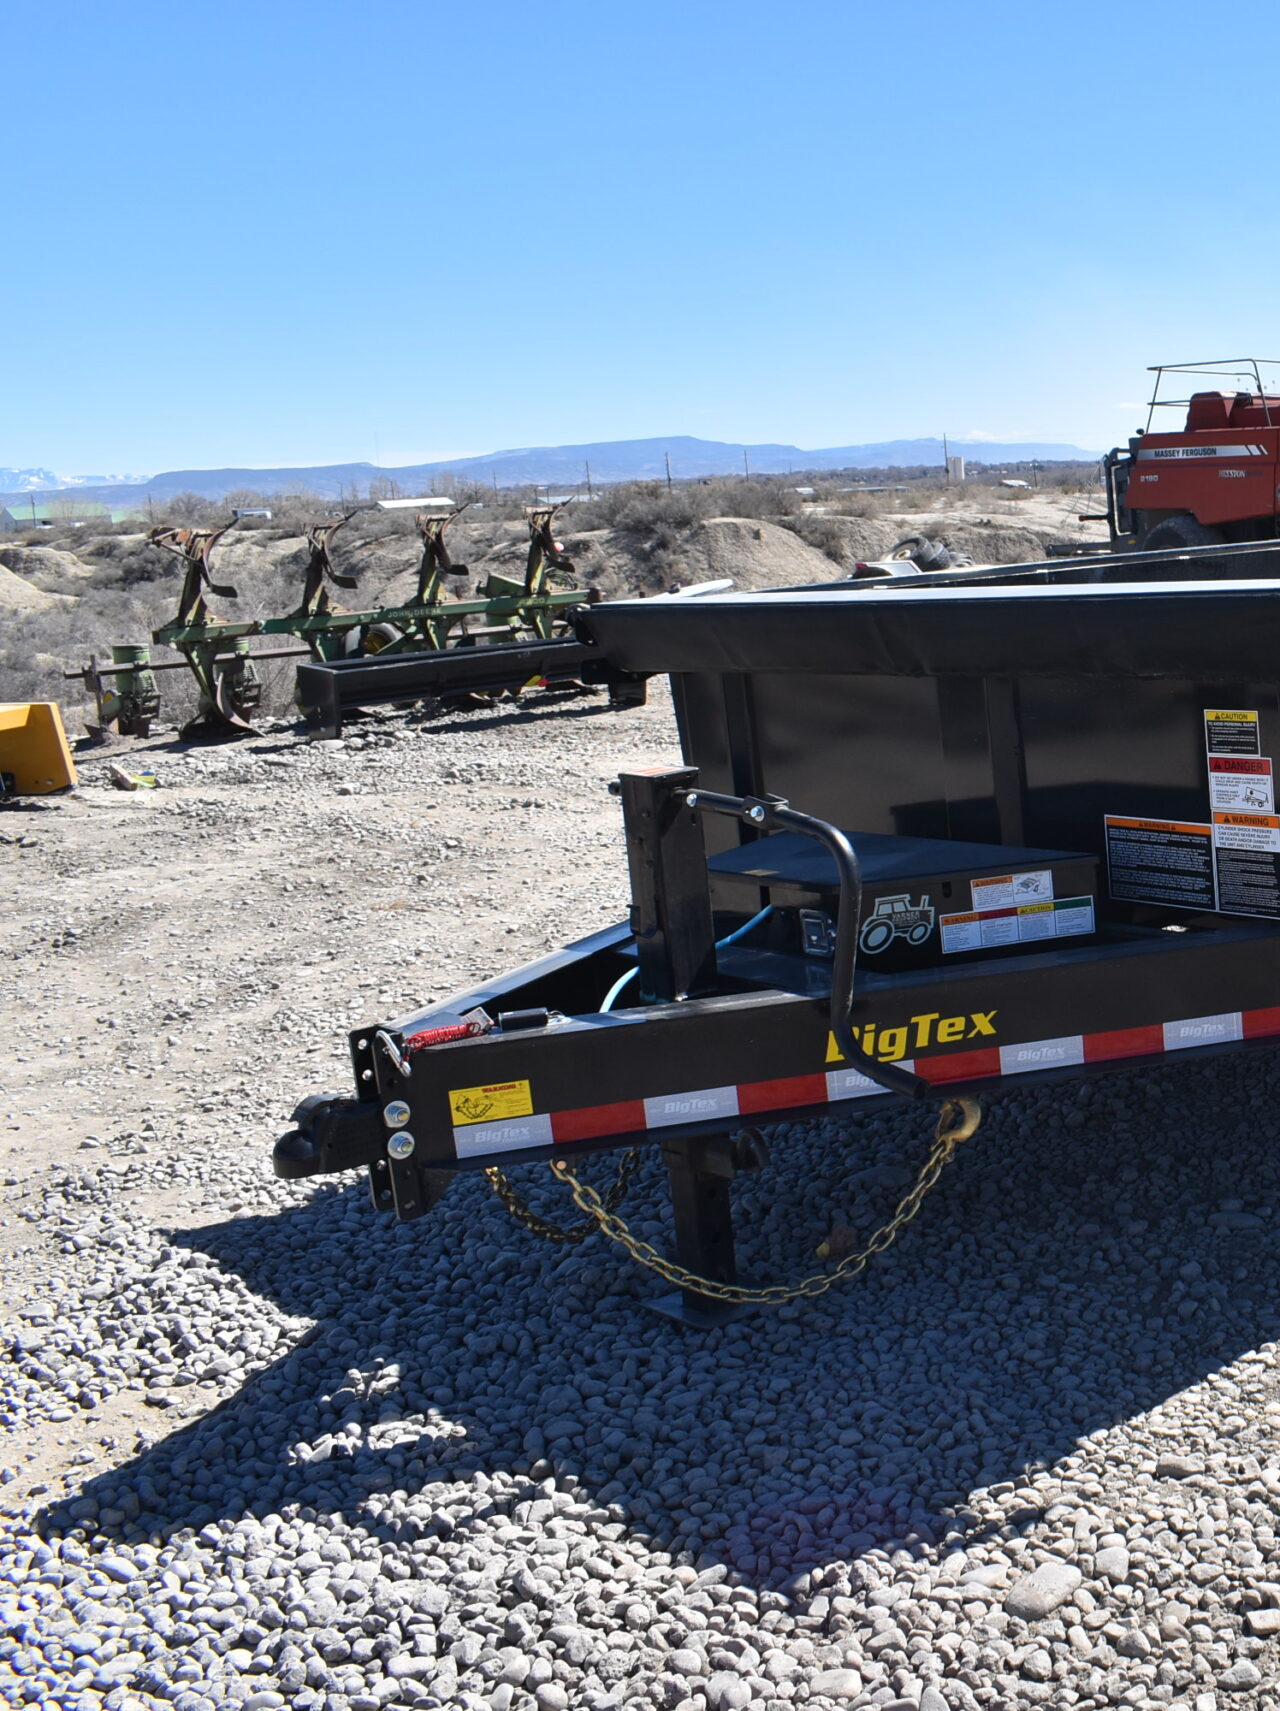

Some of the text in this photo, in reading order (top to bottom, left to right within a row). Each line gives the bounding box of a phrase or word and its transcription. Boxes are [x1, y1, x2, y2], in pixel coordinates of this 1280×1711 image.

[1154, 448, 1217, 457] MASSEY FERGUSON
[388, 608, 442, 618] JOHN DEERE
[1224, 760, 1264, 772] DANGER
[1232, 816, 1269, 826] WARNING
[1180, 1023, 1225, 1037] BigTex
[1017, 1047, 1065, 1061] BigTex
[664, 1098, 718, 1114] BigTex
[475, 1127, 530, 1143] BigTex
